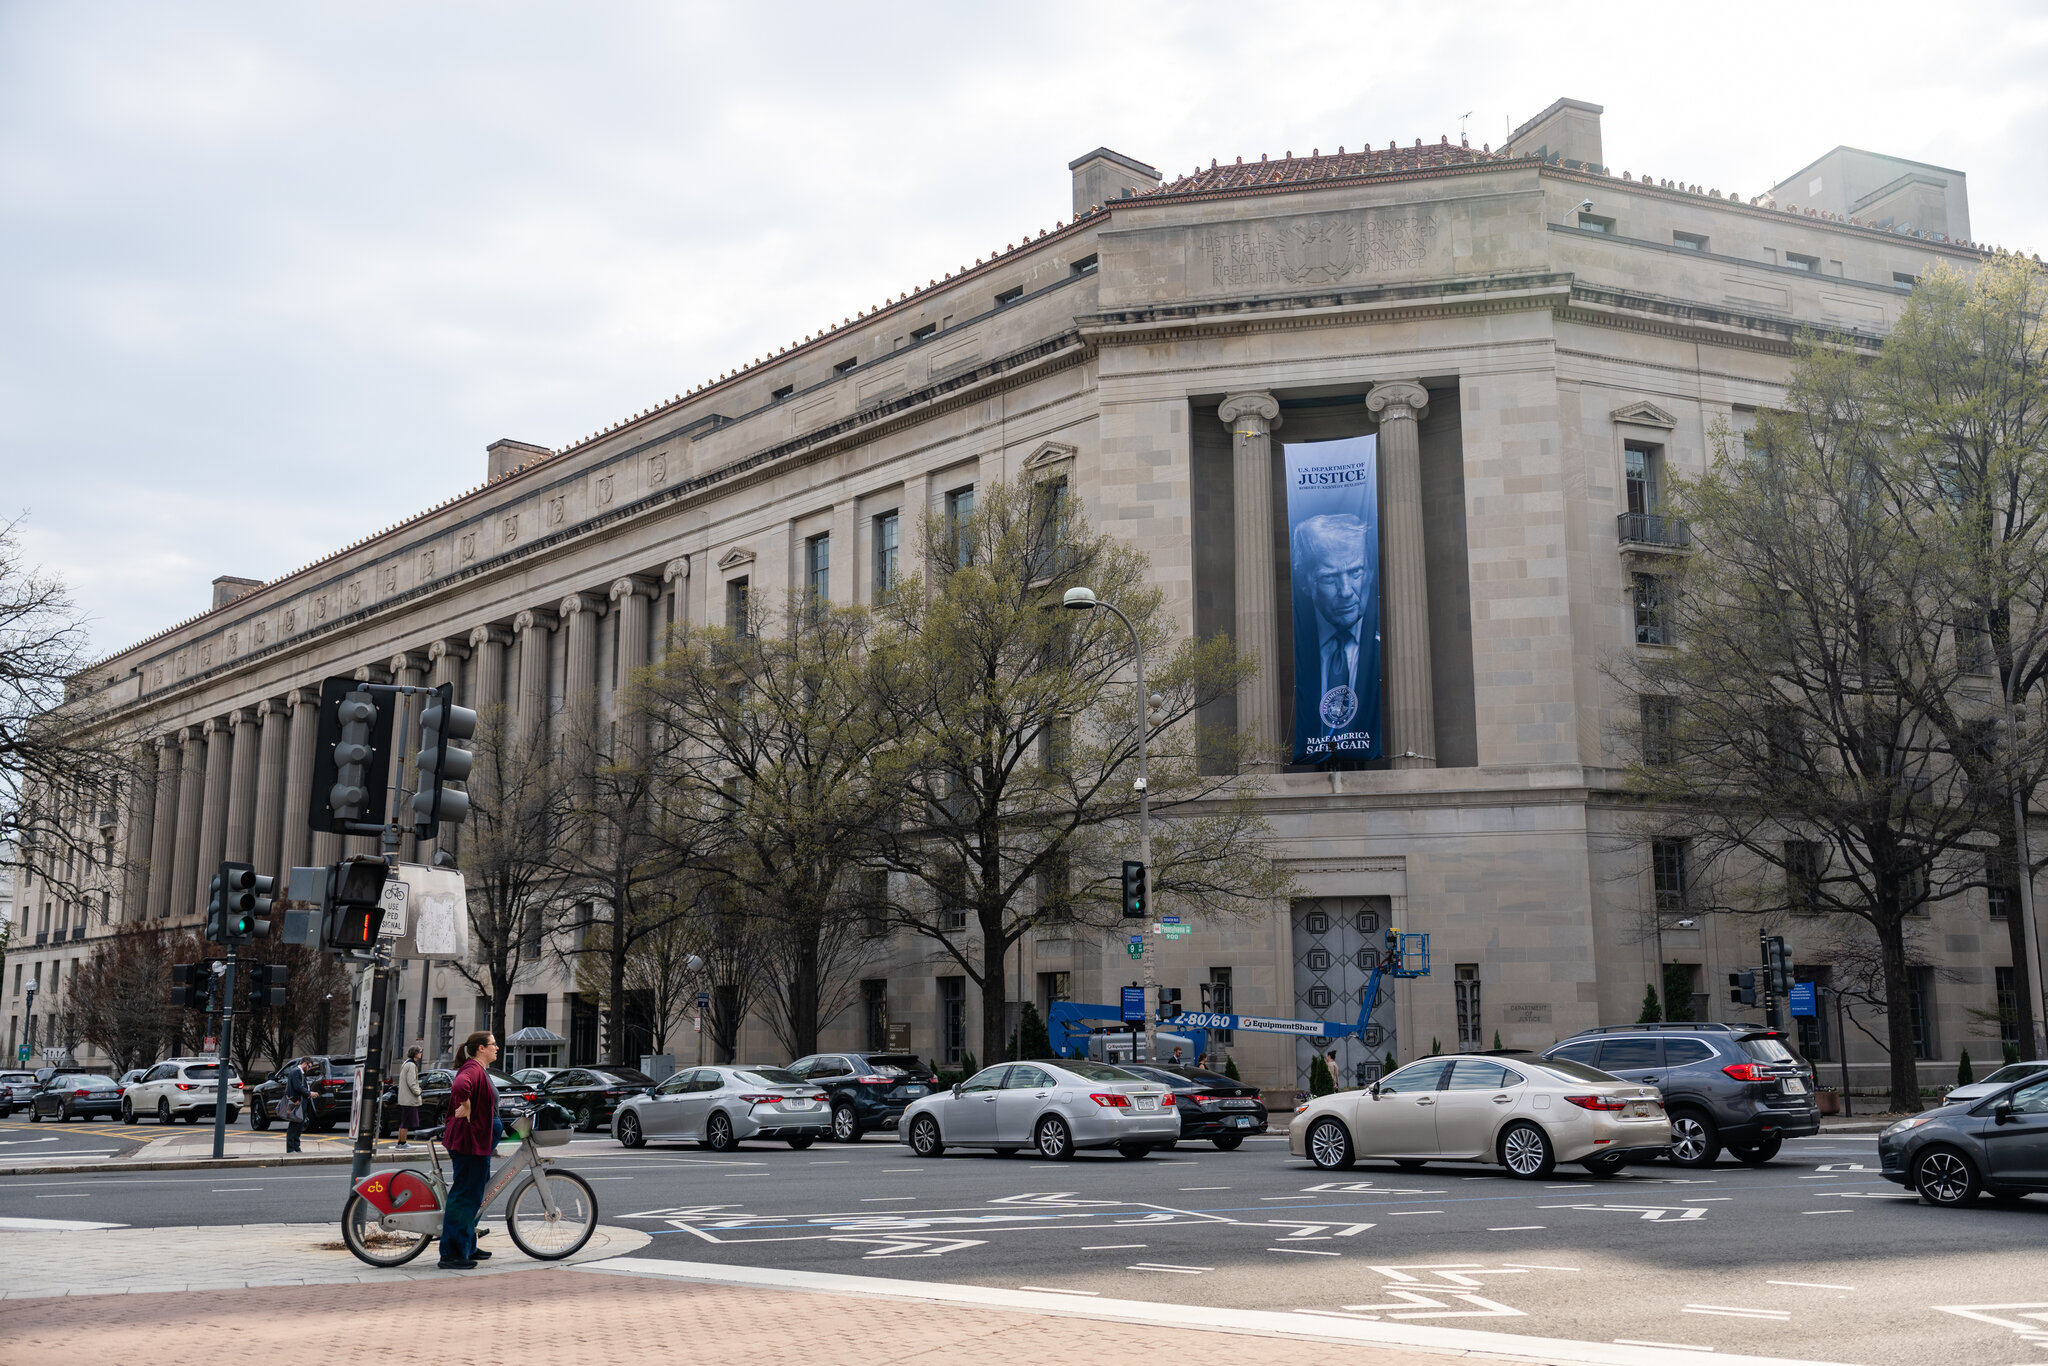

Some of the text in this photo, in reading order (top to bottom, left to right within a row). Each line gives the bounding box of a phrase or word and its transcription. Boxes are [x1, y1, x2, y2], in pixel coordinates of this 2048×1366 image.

[1202, 216, 1436, 247] JUSTICE IS FOUNDED IN
[1200, 226, 1437, 257] THE RIGHTS BESTOWED
[1213, 239, 1425, 266] BY NATURE UPON MAN
[1213, 248, 1426, 276] LIBERTY IS MAINTAINED
[1213, 259, 1425, 286] IN SECURITY OF JUSTICE
[1311, 464, 1355, 472] DEPARTMENT
[1298, 469, 1366, 484] JUSTICE
[1307, 732, 1370, 744] MAKE AMERICA
[388, 903, 399, 911] USE
[387, 911, 398, 920] PED
[382, 920, 401, 930] SIGNAL
[1174, 1013, 1230, 1028] Z-80/60
[1253, 1020, 1318, 1032] EquipmentShare
